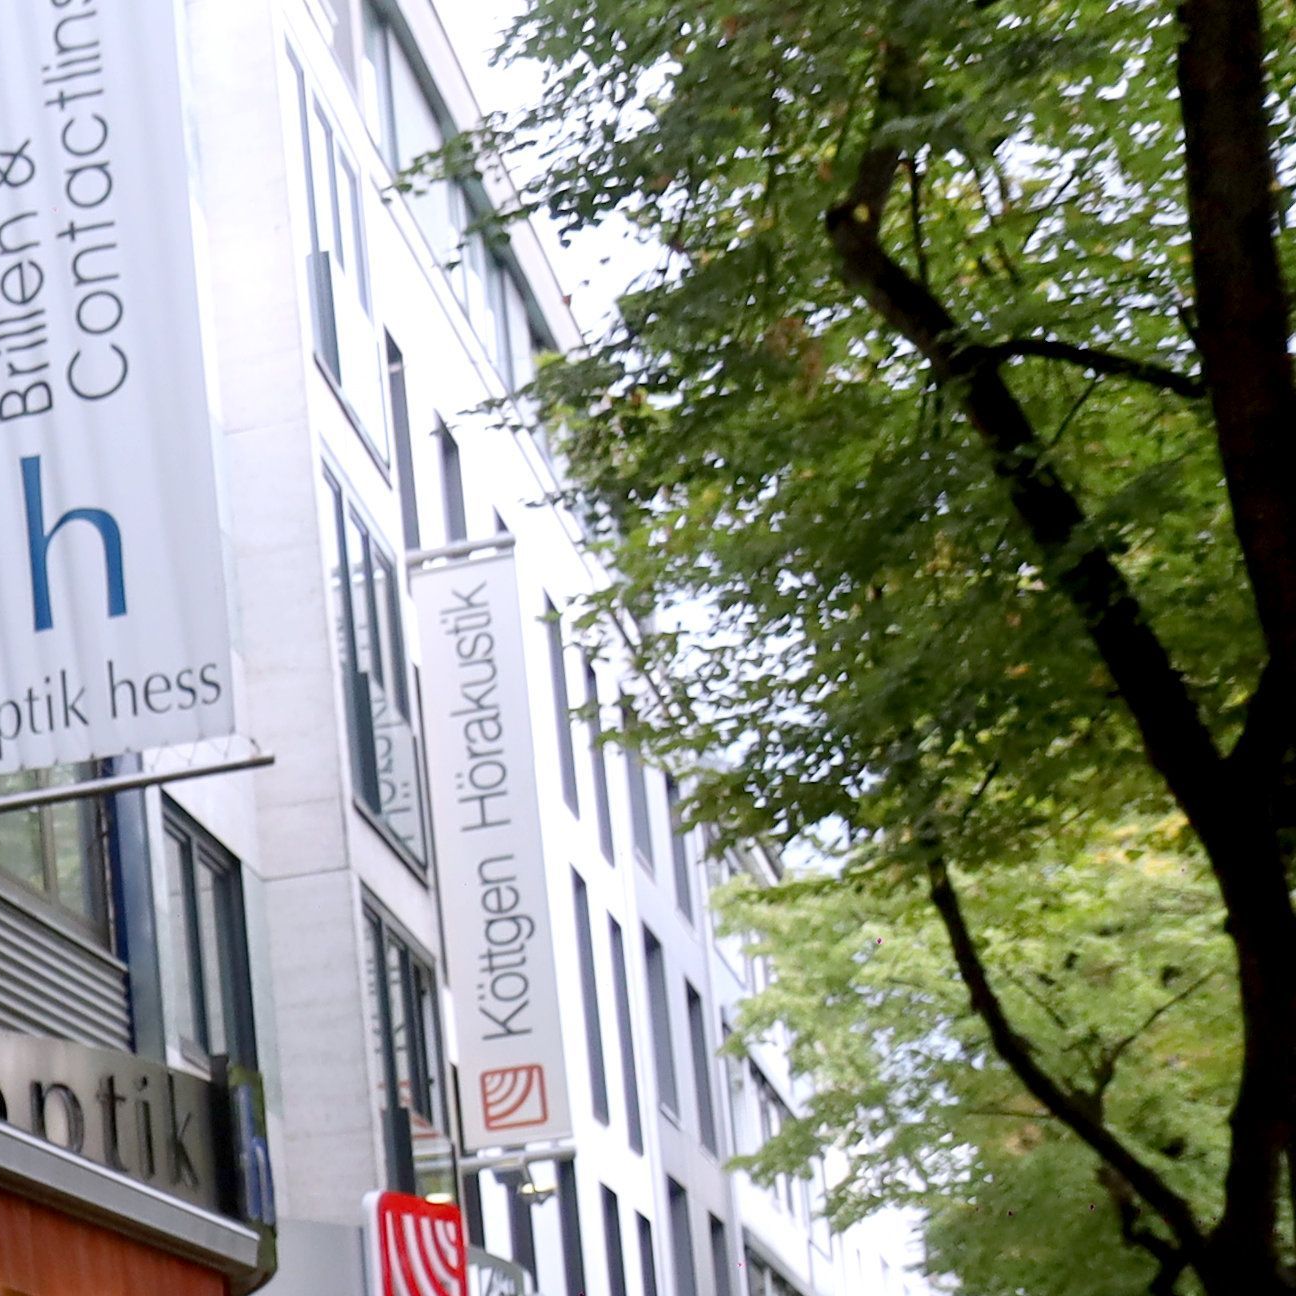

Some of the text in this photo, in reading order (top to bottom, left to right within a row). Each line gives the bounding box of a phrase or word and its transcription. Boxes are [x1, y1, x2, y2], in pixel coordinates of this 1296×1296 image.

[107, 660, 223, 721] hess
[448, 581, 536, 1041] Köttgen Hörakustik
